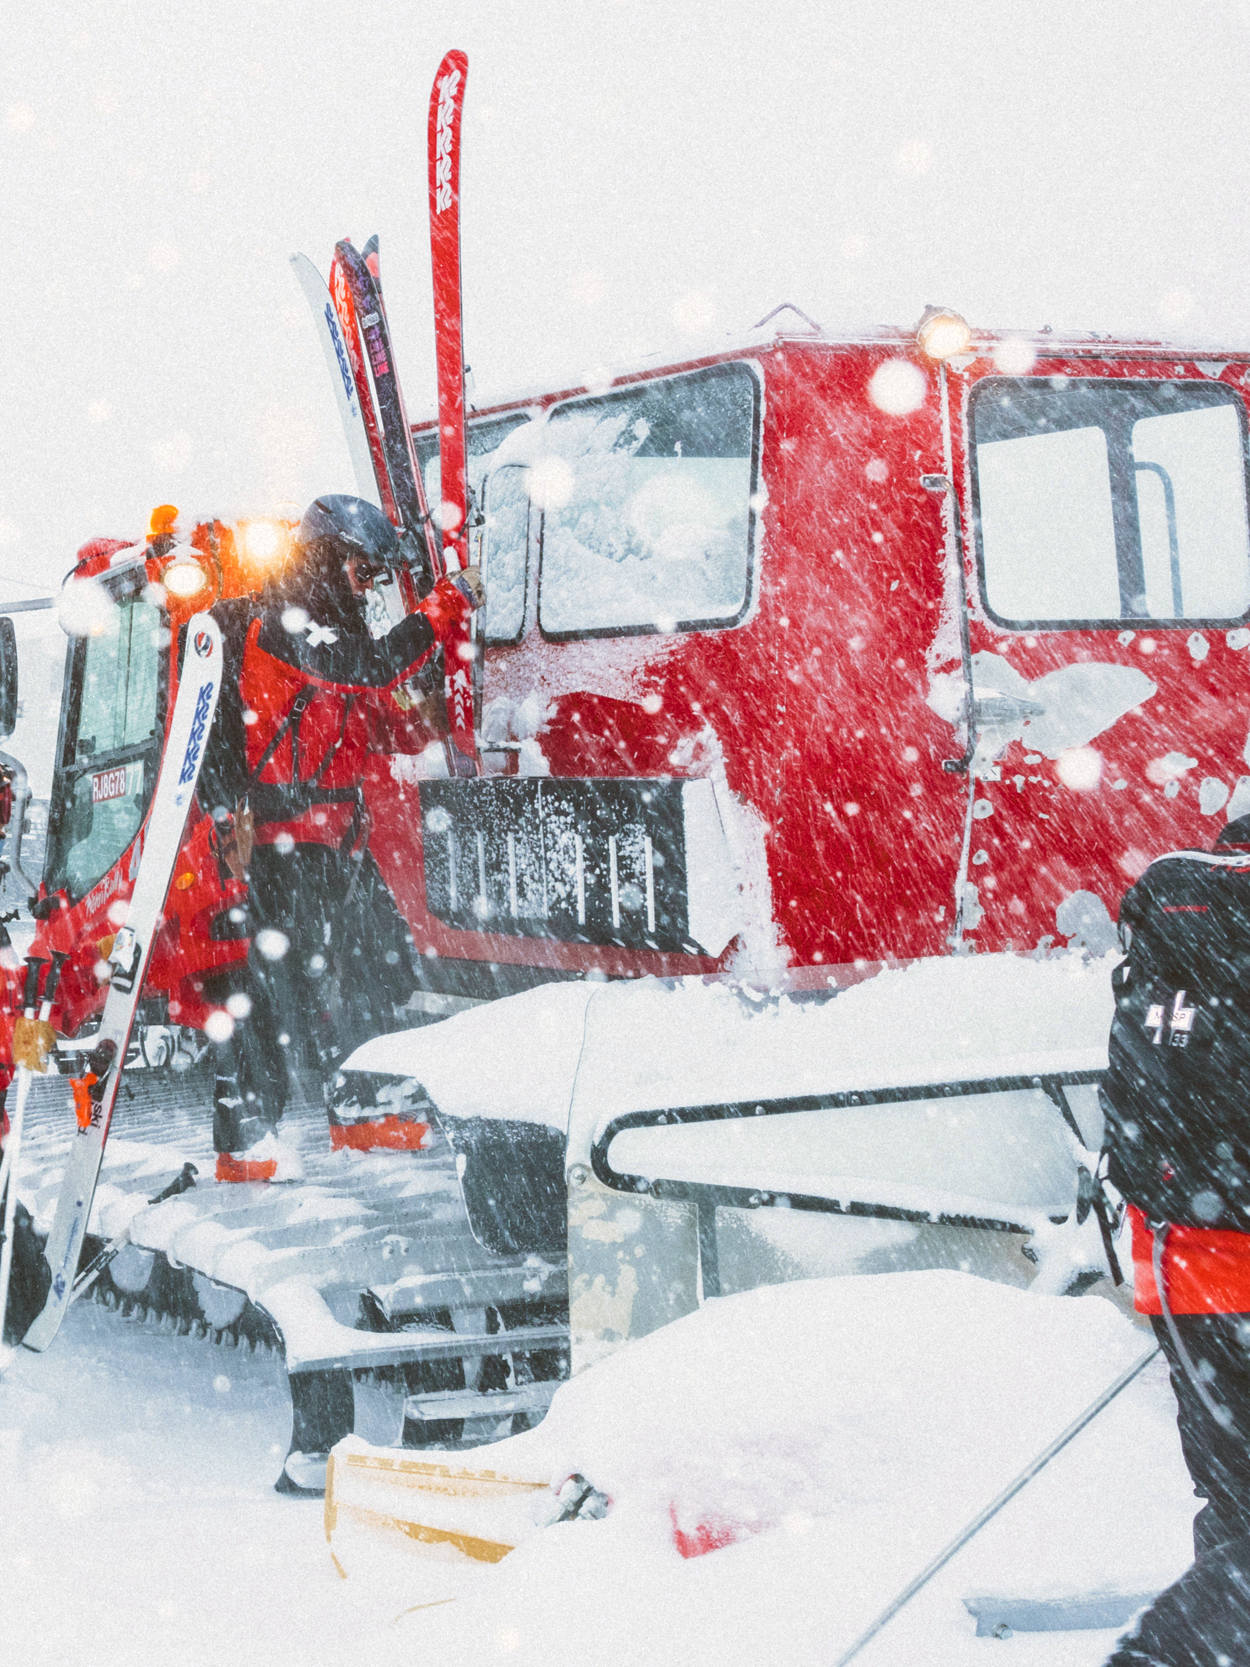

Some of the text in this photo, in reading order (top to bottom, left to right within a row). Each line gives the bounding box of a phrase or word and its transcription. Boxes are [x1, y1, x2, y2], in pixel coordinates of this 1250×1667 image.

[436, 182, 452, 215] K2
[197, 681, 214, 707] K2
[192, 702, 210, 727] K2
[188, 723, 205, 747] K2
[183, 744, 200, 768] K2
[178, 763, 196, 786] K2
[1171, 1033, 1189, 1048] 33
